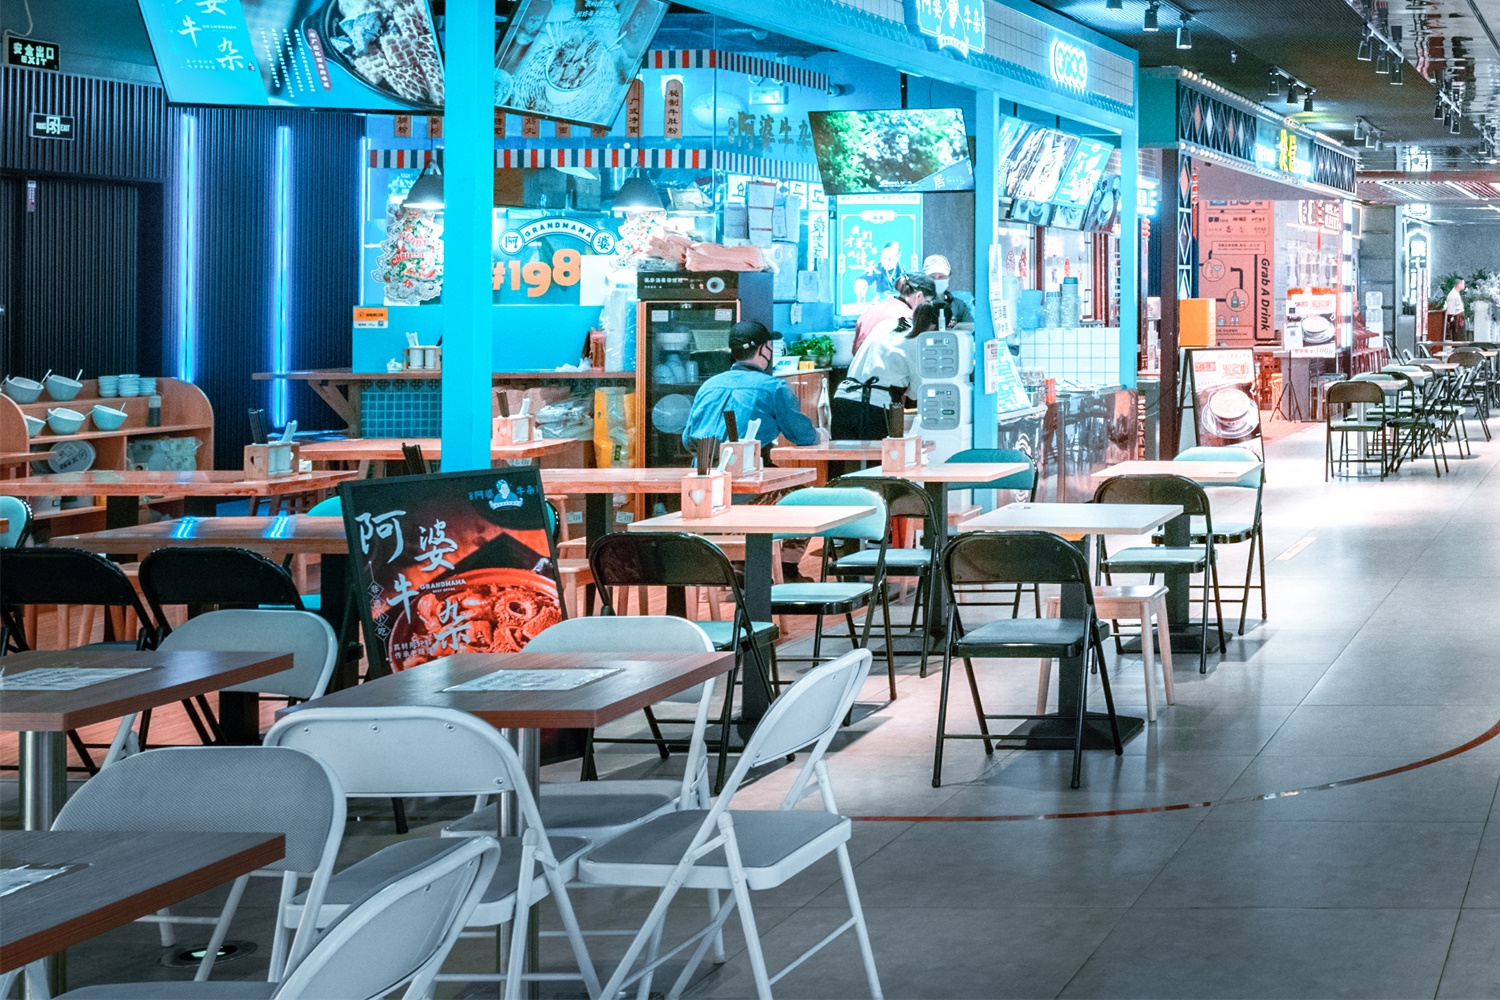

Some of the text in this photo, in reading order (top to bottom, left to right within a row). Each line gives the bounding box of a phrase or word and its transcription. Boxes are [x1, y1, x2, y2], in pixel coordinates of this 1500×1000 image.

[13, 41, 54, 61] 安全出口
[21, 54, 47, 66] EXIT
[524, 220, 593, 239] GRANDMAMA
[504, 234, 519, 249] 阿
[596, 235, 610, 250] 婆
[491, 248, 582, 298] #198
[1260, 257, 1271, 287] Grab
[1260, 299, 1271, 332] Drink
[419, 578, 467, 592] GRANDMAMA
